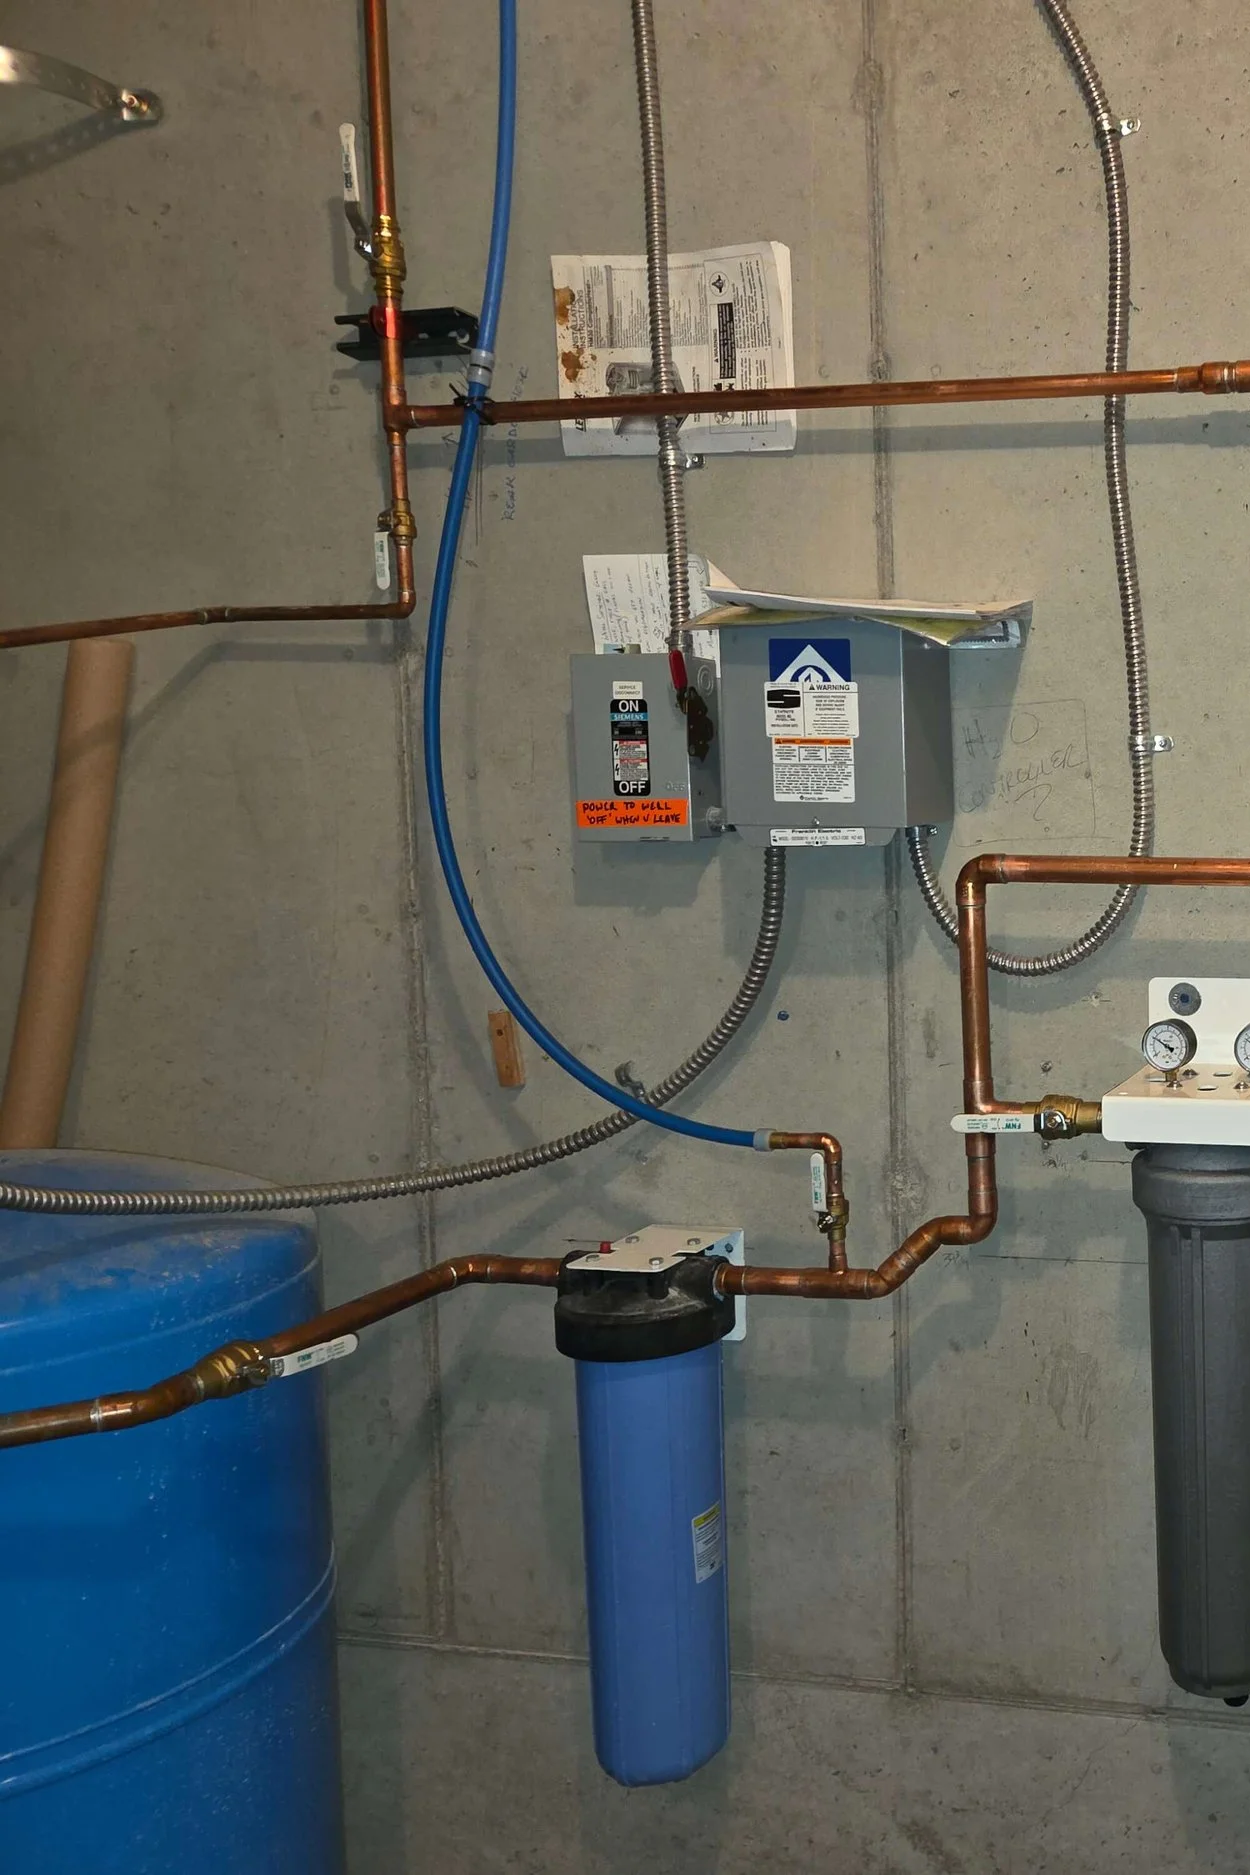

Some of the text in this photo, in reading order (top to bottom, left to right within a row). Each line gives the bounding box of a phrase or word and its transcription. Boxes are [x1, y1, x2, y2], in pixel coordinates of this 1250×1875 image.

[618, 700, 639, 712] ON
[619, 781, 646, 793] OFF
[616, 815, 640, 824] WHEN
[653, 813, 681, 823] LEAVE
